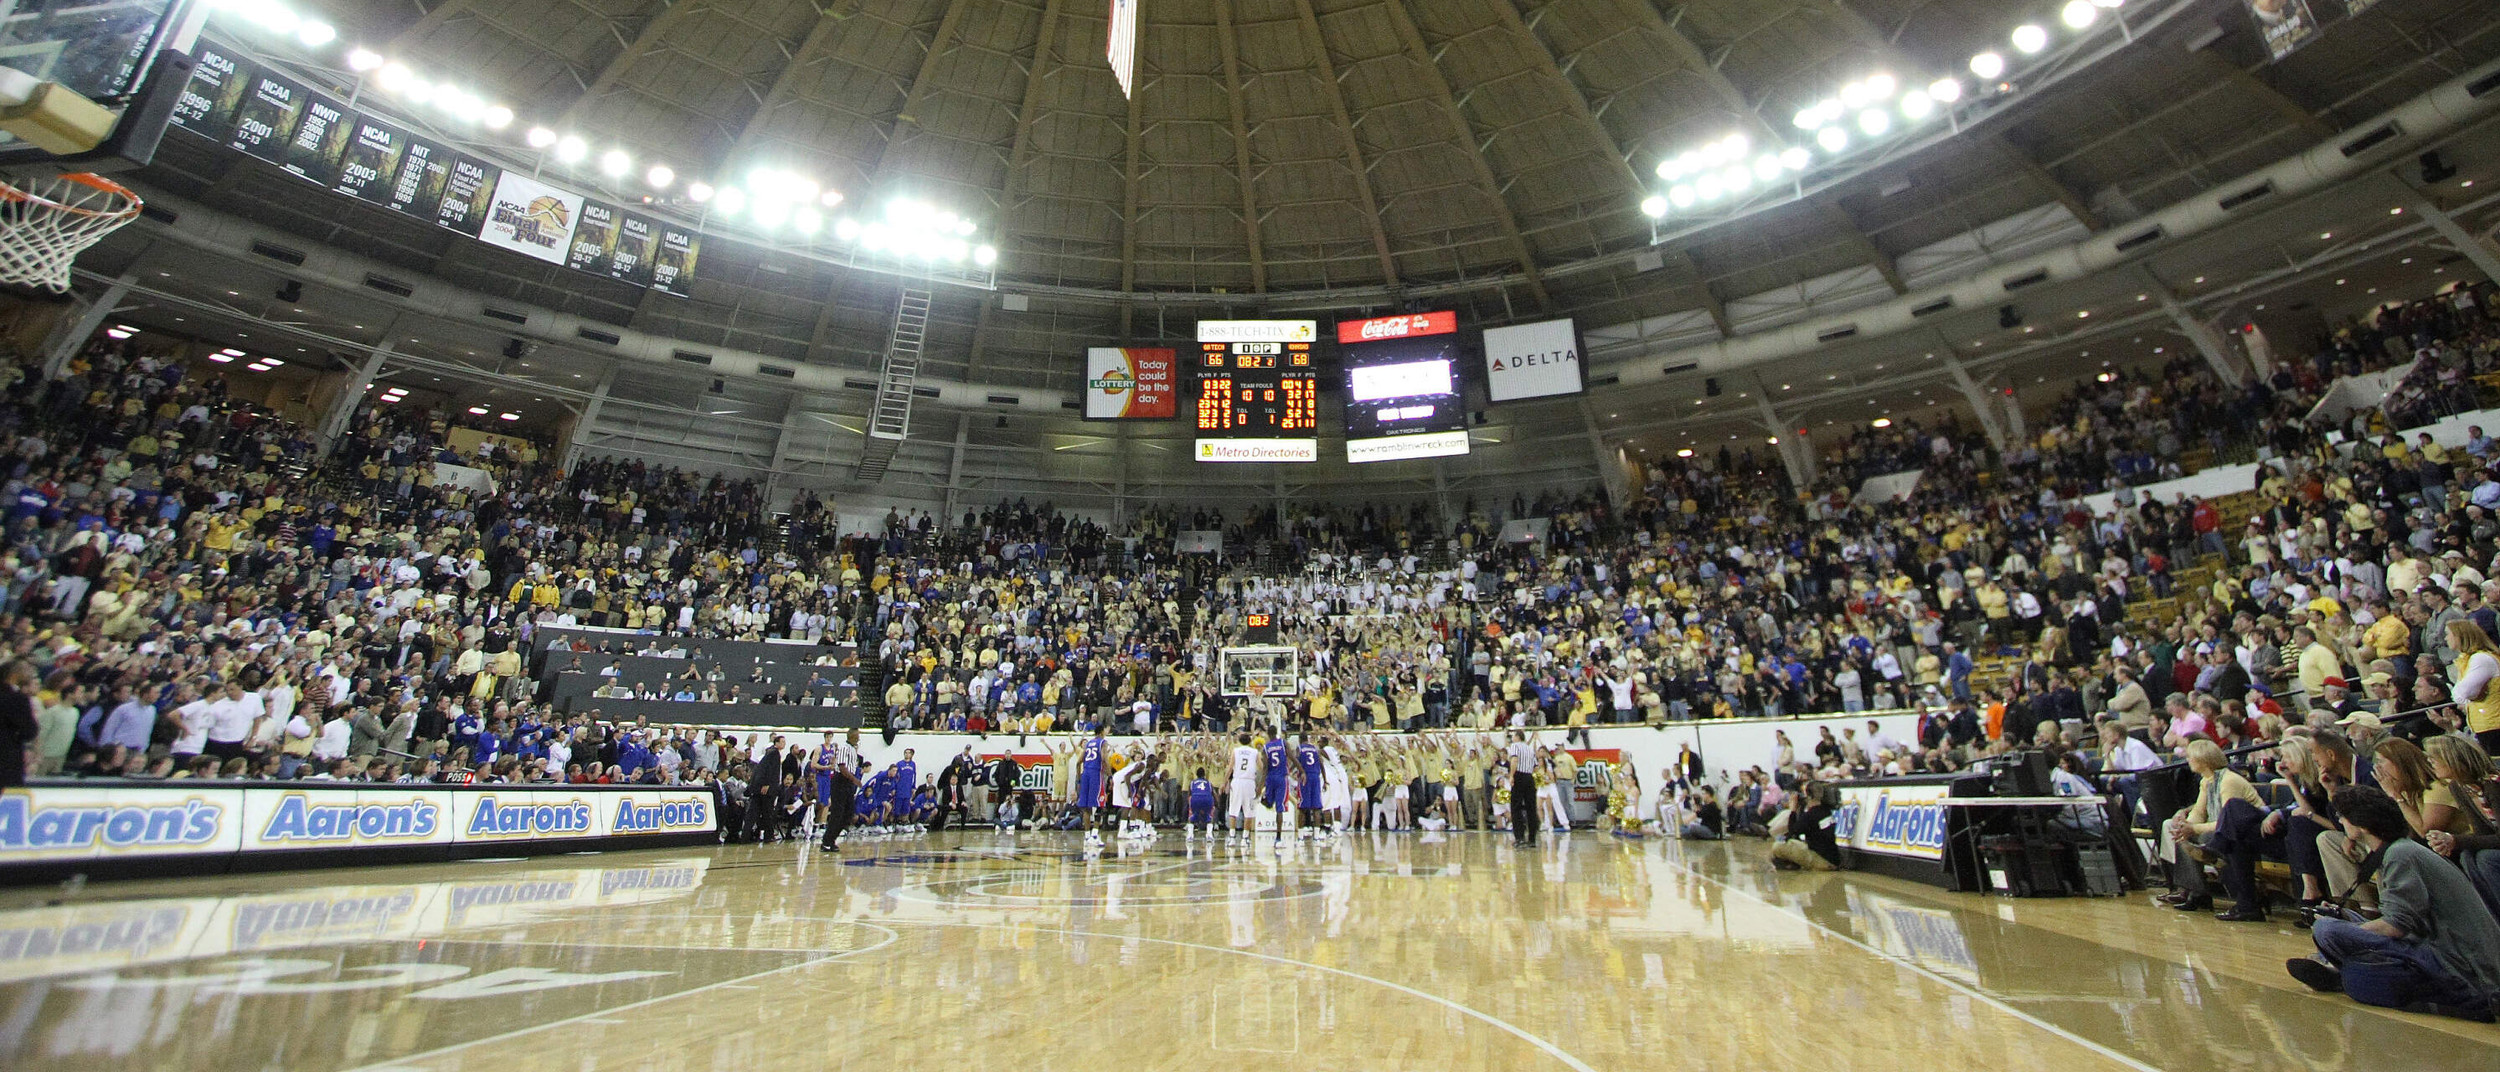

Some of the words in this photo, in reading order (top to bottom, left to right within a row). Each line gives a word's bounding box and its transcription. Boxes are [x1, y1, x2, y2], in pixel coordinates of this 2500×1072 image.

[202, 51, 235, 75] NCAA
[261, 78, 290, 101] NCAA
[182, 91, 212, 112] 1996
[175, 104, 204, 120] 24-12
[311, 102, 341, 123] NWIT
[309, 114, 327, 127] 1992
[241, 118, 273, 138] 2001
[304, 122, 325, 136] 2000
[237, 130, 261, 145] 17-13
[300, 129, 320, 143] 2001
[361, 125, 391, 145] NCAA
[297, 137, 318, 151] 2002
[411, 143, 431, 159] NIT
[409, 155, 426, 167] 1970
[345, 162, 377, 181] 2003
[406, 162, 423, 174] 1971
[457, 161, 483, 180] NCAA
[341, 174, 366, 188] 20-11
[400, 177, 418, 189] 1994
[397, 184, 415, 196] 1998
[394, 192, 413, 204] 1999
[444, 197, 468, 214] 2004
[497, 200, 526, 214] NCAA
[441, 208, 463, 222] 28-10
[491, 207, 541, 231] Final
[585, 205, 611, 221] NCAA
[625, 218, 648, 234] NCAA
[511, 229, 557, 249] Four
[666, 231, 688, 246] NCAA
[575, 241, 602, 257] 2005
[572, 252, 593, 264] 20-12
[615, 251, 637, 265] 2007
[613, 261, 631, 273] 20-12
[657, 263, 679, 277] 2007
[655, 273, 673, 284] 21-12
[1138, 360, 1168, 370] Today
[1208, 354, 1223, 365] 66
[1293, 354, 1308, 365] 68
[1511, 350, 1577, 368] DELTA
[1138, 372, 1166, 380] could
[1094, 380, 1135, 388] LOTTERY
[1138, 383, 1151, 391] be
[1154, 383, 1169, 391] the
[1203, 380, 1210, 389] 0
[1212, 380, 1218, 389] 3
[1219, 380, 1231, 389] 22
[1282, 380, 1294, 390] 00
[1294, 380, 1302, 389] 4
[1138, 394, 1159, 404] day.
[1203, 390, 1210, 399] 2
[1211, 390, 1218, 399] 4
[1223, 390, 1231, 399] 9
[1242, 390, 1253, 401] 10
[1263, 390, 1275, 401] 10
[1288, 390, 1294, 399] 3
[1295, 390, 1302, 399] 2
[1305, 390, 1315, 399] 17
[1199, 399, 1210, 408] 23
[1211, 399, 1218, 408] 4
[1221, 399, 1231, 408] 12
[1287, 399, 1294, 408] 4
[1307, 399, 1315, 408] 8
[1199, 409, 1210, 418] 32
[1211, 409, 1218, 418] 3
[1223, 409, 1231, 418] 2
[1238, 413, 1246, 425] 0
[1287, 409, 1294, 418] 5
[1295, 409, 1302, 418] 2
[1307, 409, 1315, 418] 4
[1199, 418, 1210, 428] 35
[1211, 418, 1218, 428] 2
[1223, 418, 1231, 428] 5
[1282, 418, 1294, 428] 25
[1305, 418, 1315, 427] 11
[1215, 447, 1250, 457] Metro
[1251, 447, 1310, 457] Directories
[1351, 439, 1466, 454] www.ramblinwreck.com
[1085, 747, 1098, 761] 25
[1271, 752, 1280, 767] 5
[1306, 752, 1315, 765] 3
[1240, 758, 1249, 771] 2
[446, 772, 467, 783] POSS
[1196, 782, 1206, 790] 4
[262, 795, 438, 840] Aaron's
[466, 796, 592, 836] Aaron's
[613, 799, 706, 832] Aaron's
